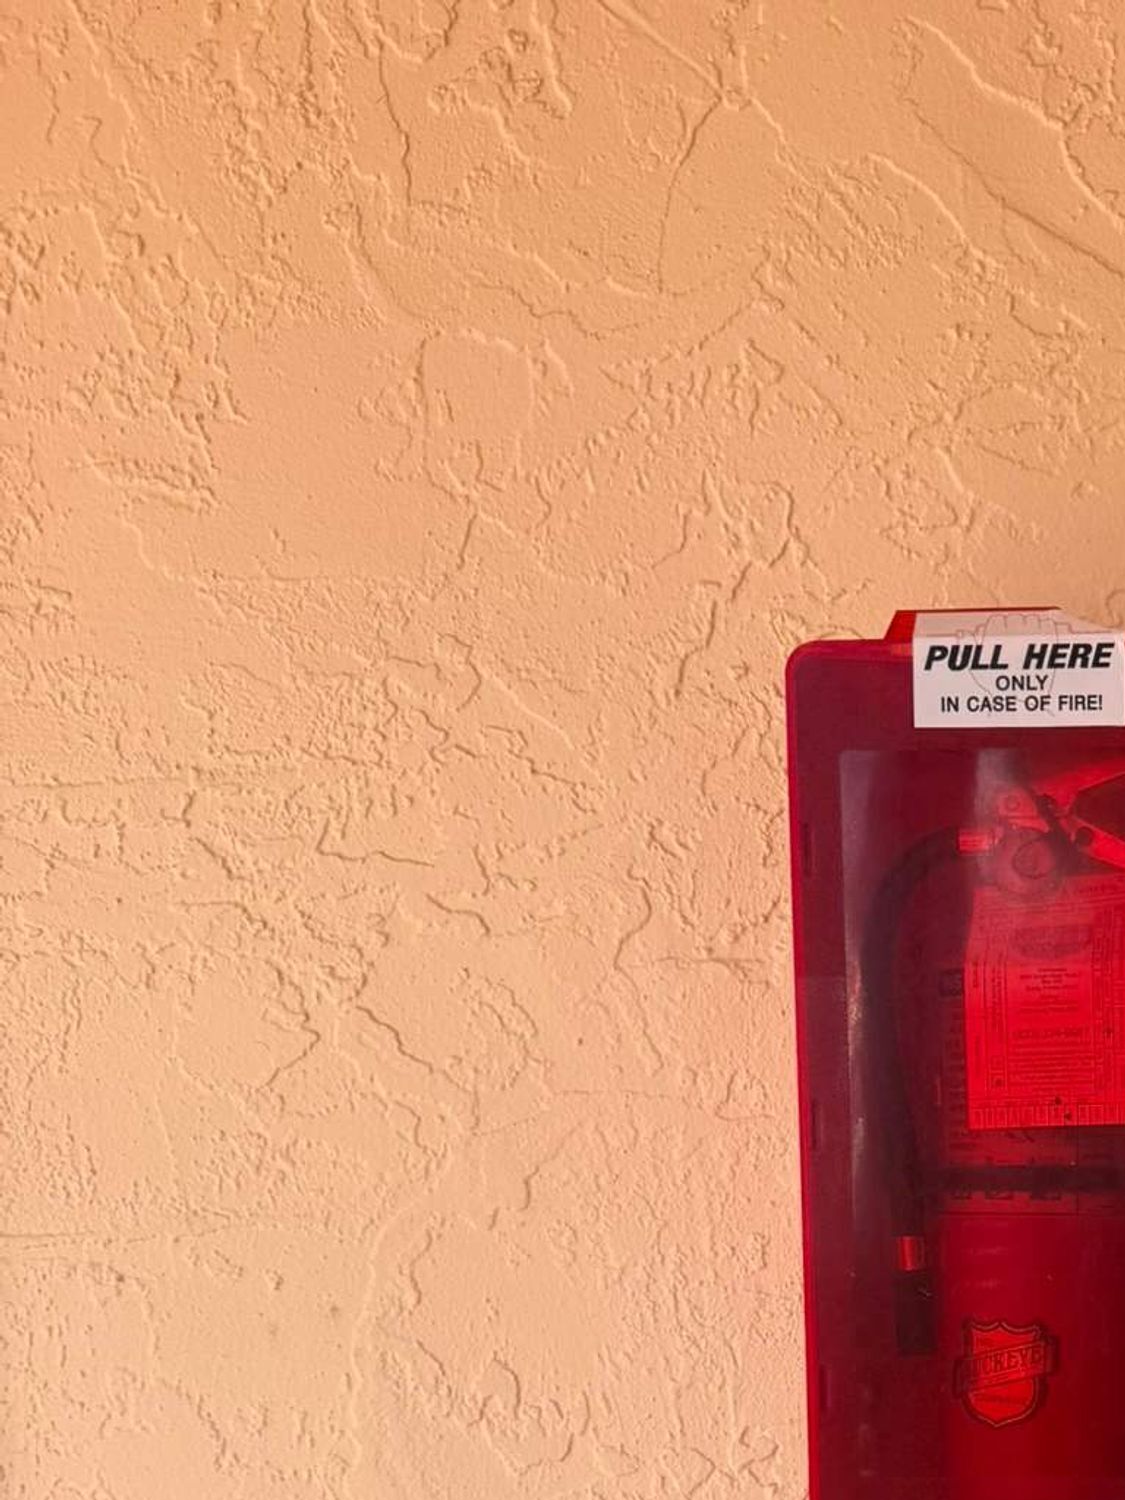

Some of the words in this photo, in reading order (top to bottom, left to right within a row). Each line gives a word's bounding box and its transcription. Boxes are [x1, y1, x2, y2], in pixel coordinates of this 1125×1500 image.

[924, 645, 1008, 671] PULL
[1022, 642, 1115, 669] HERE
[995, 675, 1049, 691] ONLY
[941, 696, 960, 712] IN
[967, 695, 1017, 712] CASE
[1025, 695, 1051, 712] OF
[1058, 694, 1103, 711] FIRE!
